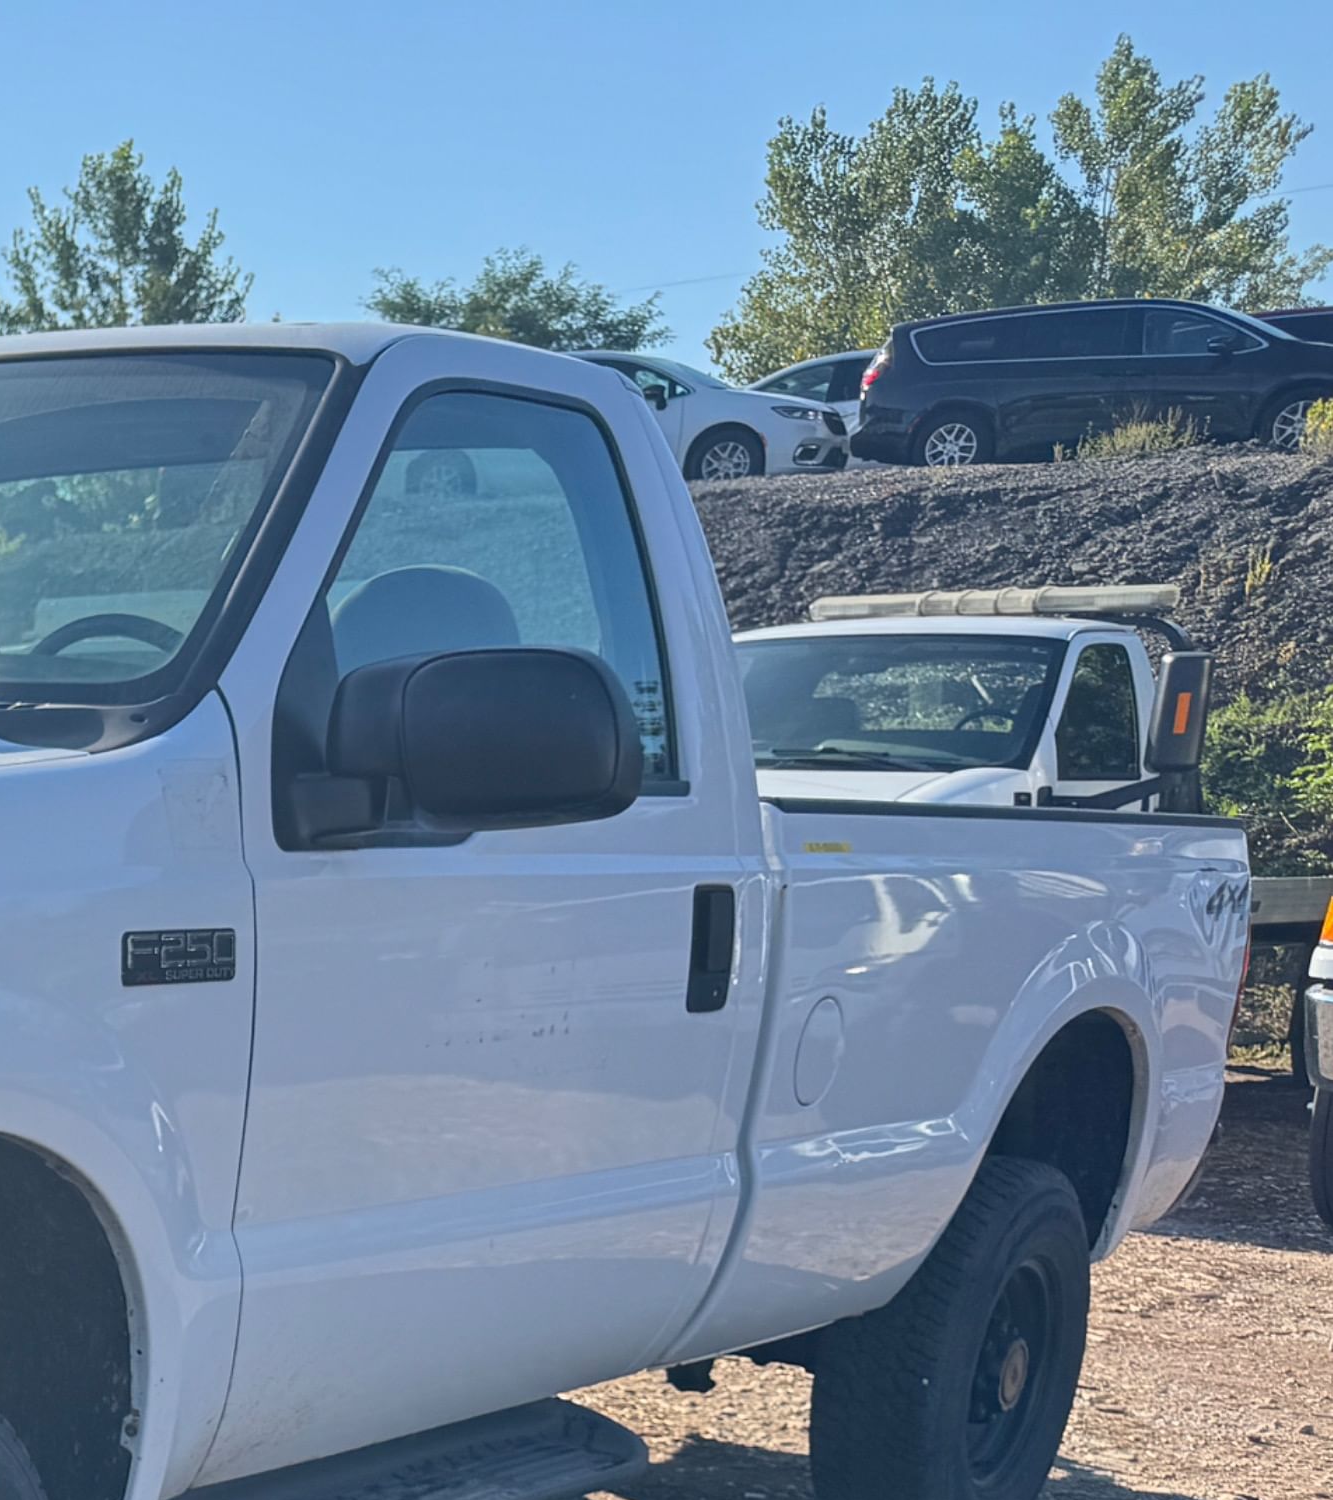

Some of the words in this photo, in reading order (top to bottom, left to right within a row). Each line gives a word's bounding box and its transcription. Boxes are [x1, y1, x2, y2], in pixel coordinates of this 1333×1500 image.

[127, 931, 235, 969] F-250
[165, 968, 204, 981] SUPER
[205, 966, 235, 979] DUTY
